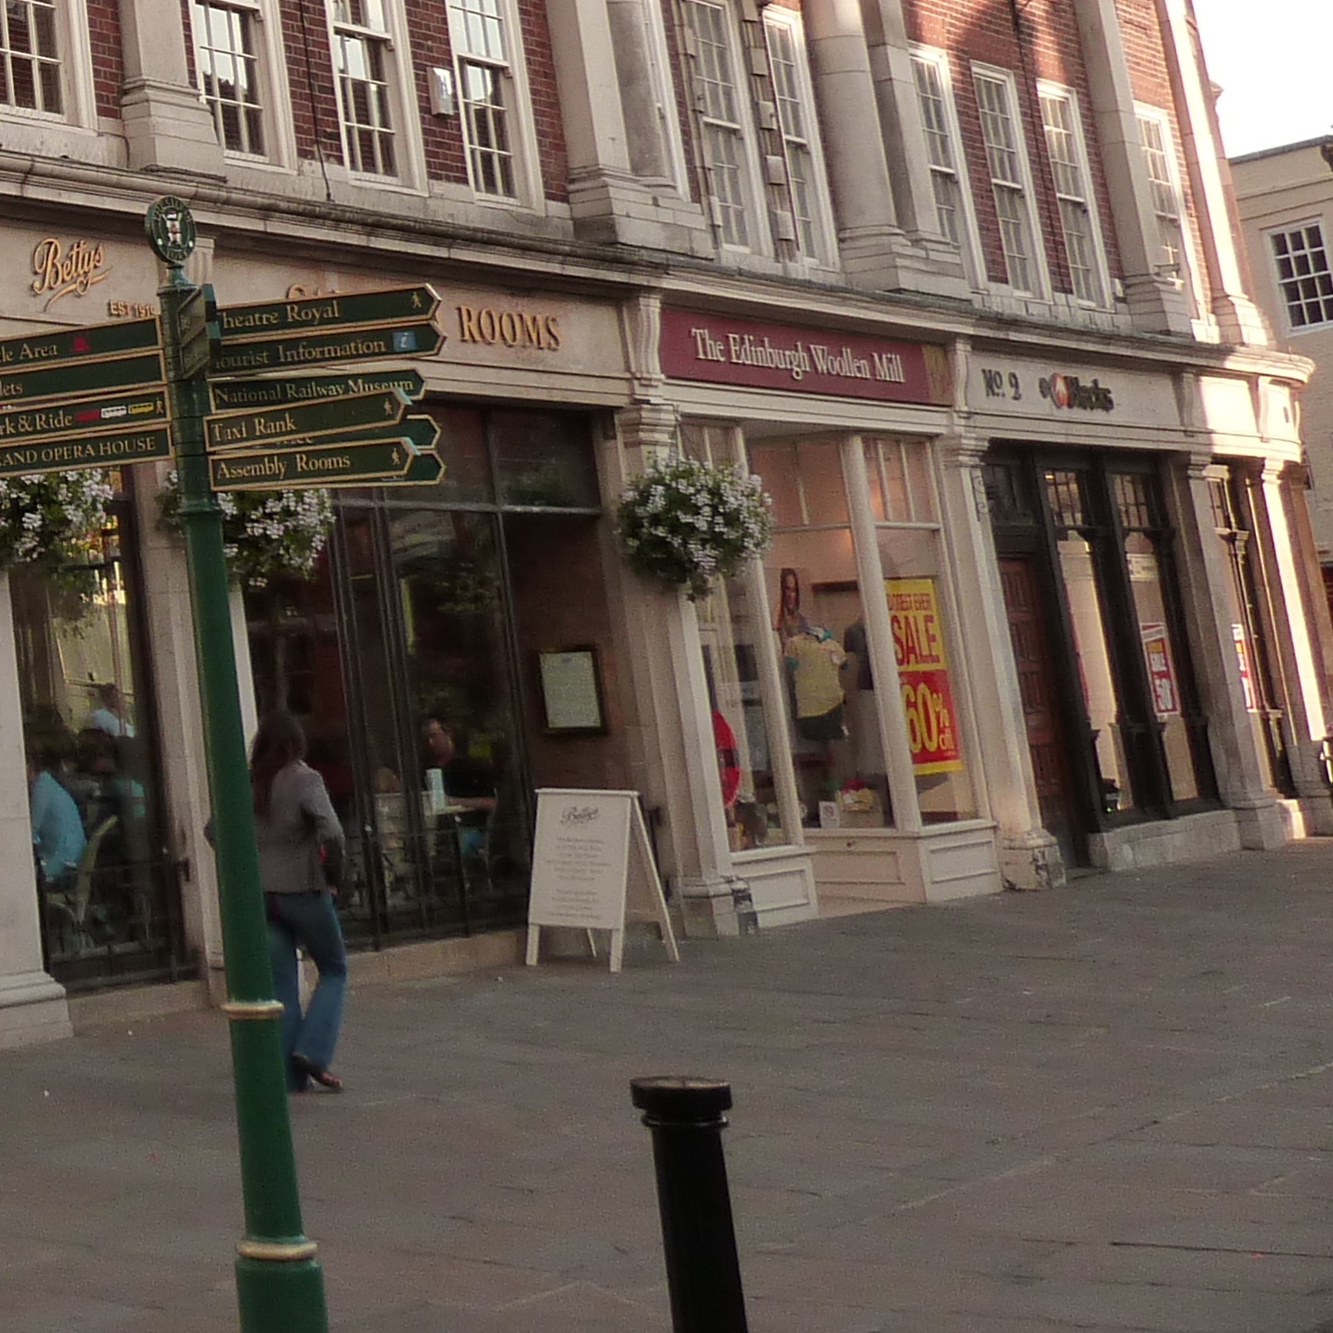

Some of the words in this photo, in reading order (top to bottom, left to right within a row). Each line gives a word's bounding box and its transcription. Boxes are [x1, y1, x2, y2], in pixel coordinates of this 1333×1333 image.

[33, 237, 112, 311] Bettys
[109, 299, 131, 316] EST
[133, 302, 157, 316] 1919
[286, 300, 340, 326] Royal
[456, 305, 563, 351] ROOMS
[19, 343, 58, 359] Area
[215, 351, 270, 369] ourist
[278, 338, 386, 363] Information
[691, 328, 726, 362] The
[727, 333, 811, 380] Edinburgh
[809, 344, 871, 380] Woollen
[872, 352, 906, 383] Mill
[214, 383, 281, 404] National
[286, 380, 345, 399] Railway
[253, 413, 297, 435] Rank
[41, 444, 95, 463] OPERA
[100, 437, 156, 455] HOUSE
[216, 455, 288, 479] Assembly
[295, 453, 351, 472] Rooms
[890, 615, 940, 666] SALE
